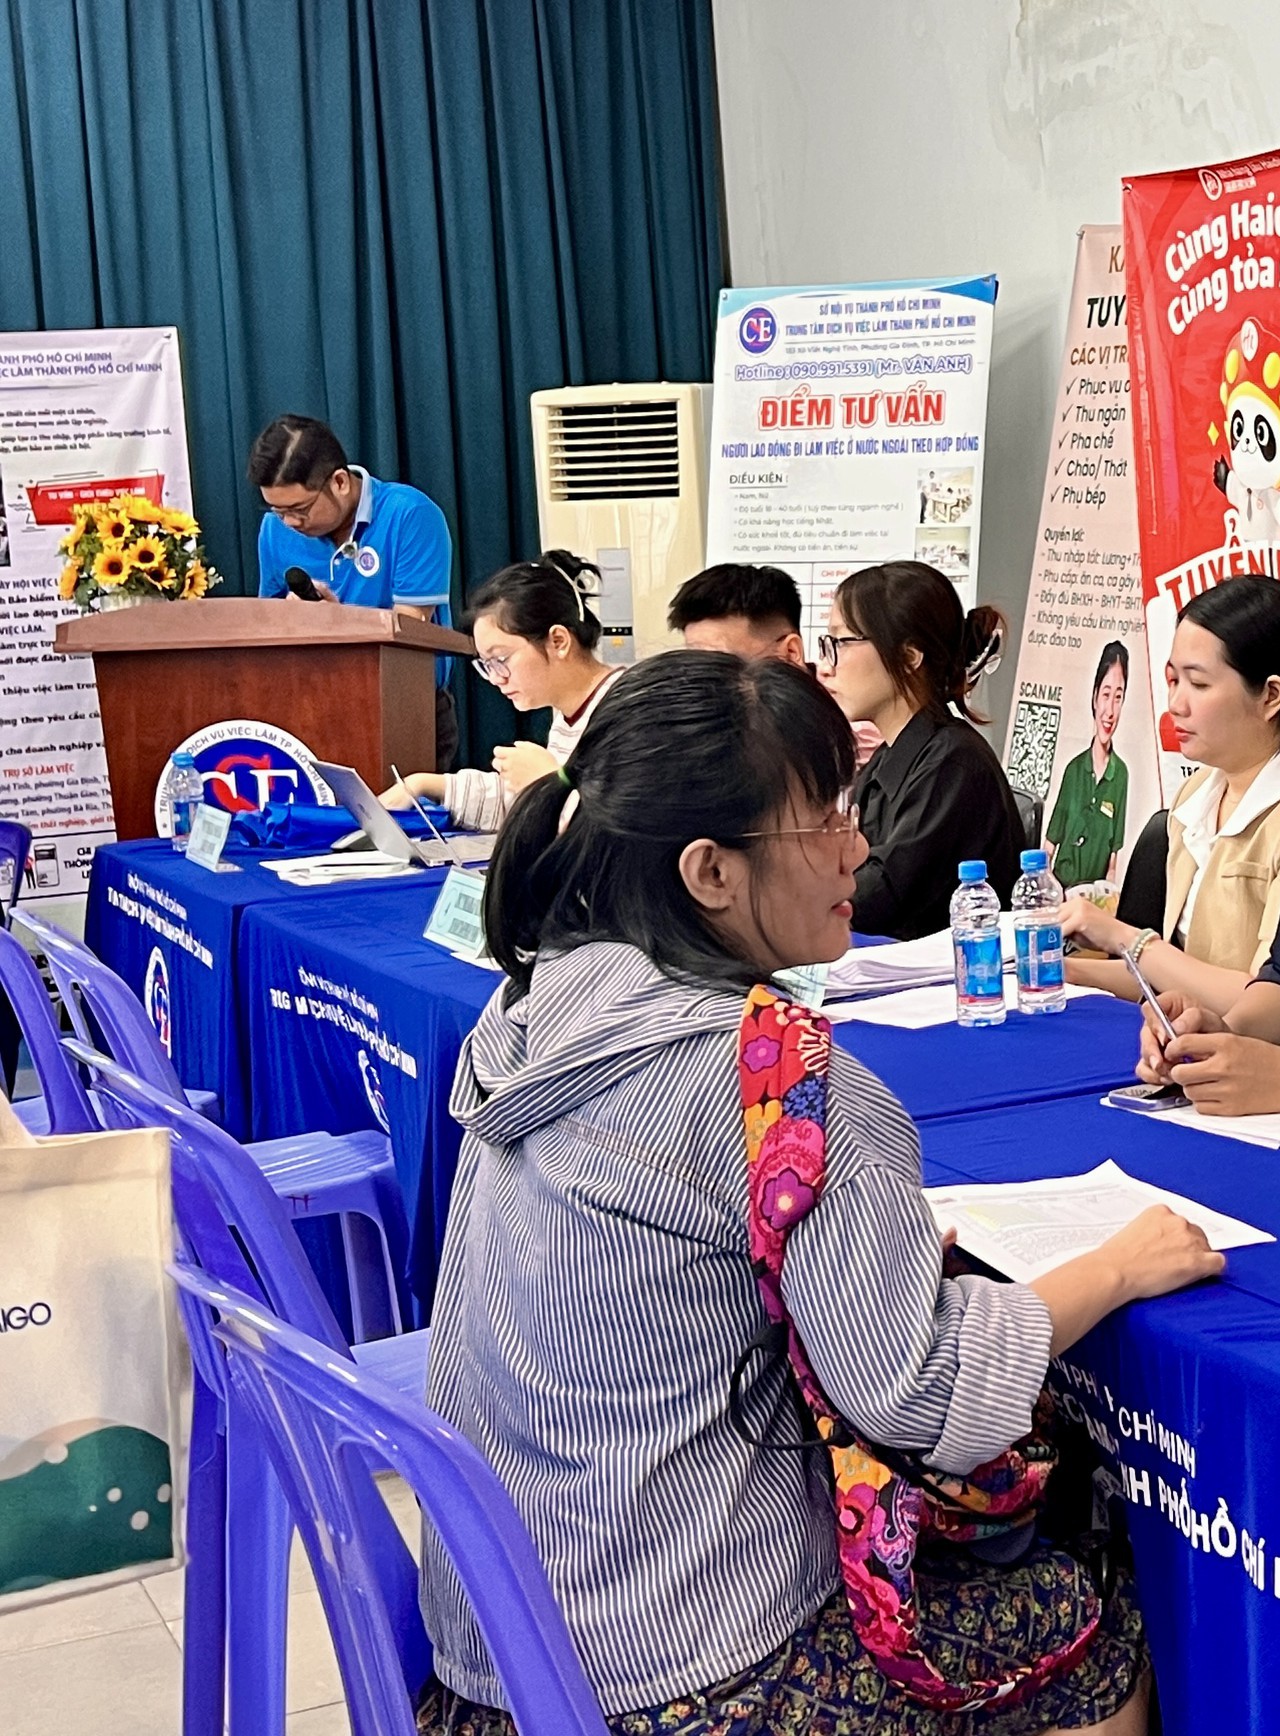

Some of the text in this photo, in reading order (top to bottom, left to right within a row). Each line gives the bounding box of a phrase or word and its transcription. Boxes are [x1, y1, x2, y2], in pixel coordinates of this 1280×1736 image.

[1108, 245, 1124, 273] K
[1230, 242, 1274, 293] tỏa
[22, 352, 112, 364] PHỐ HỒ CHÍ MINH
[1071, 342, 1096, 366] CÁC
[11, 362, 163, 377] LÀM THÀNH PHỐ HỒ CHÍ MINH
[1078, 378, 1122, 401] Phục vụ
[760, 382, 943, 427] ĐIỂM TƯ VẤN
[1075, 403, 1125, 427] Thu ngân
[911, 438, 932, 453] THEO
[1071, 428, 1114, 449] Pha chế
[1062, 483, 1106, 510] Phụ bếp
[32, 578, 53, 590] VIỆC
[1037, 610, 1063, 630] Không
[1065, 612, 1080, 630] yêu
[1082, 612, 1097, 629] cầu
[33, 684, 52, 695] việc
[55, 683, 74, 692] làm
[1019, 681, 1062, 702] SCAN ME
[21, 711, 86, 724] theo yêu cầu
[6, 741, 93, 756] cho doanh nghiệp
[210, 729, 225, 741] VỤ
[227, 726, 252, 737] VIỆC
[254, 726, 277, 742] LÀM
[280, 737, 293, 749] TP
[0, 1302, 52, 1333] IGO
[1158, 1423, 1196, 1479] MINH
[1158, 1477, 1191, 1538] PHỐ
[1190, 1497, 1237, 1558] HỒ
[1241, 1528, 1266, 1591] CHÍ
